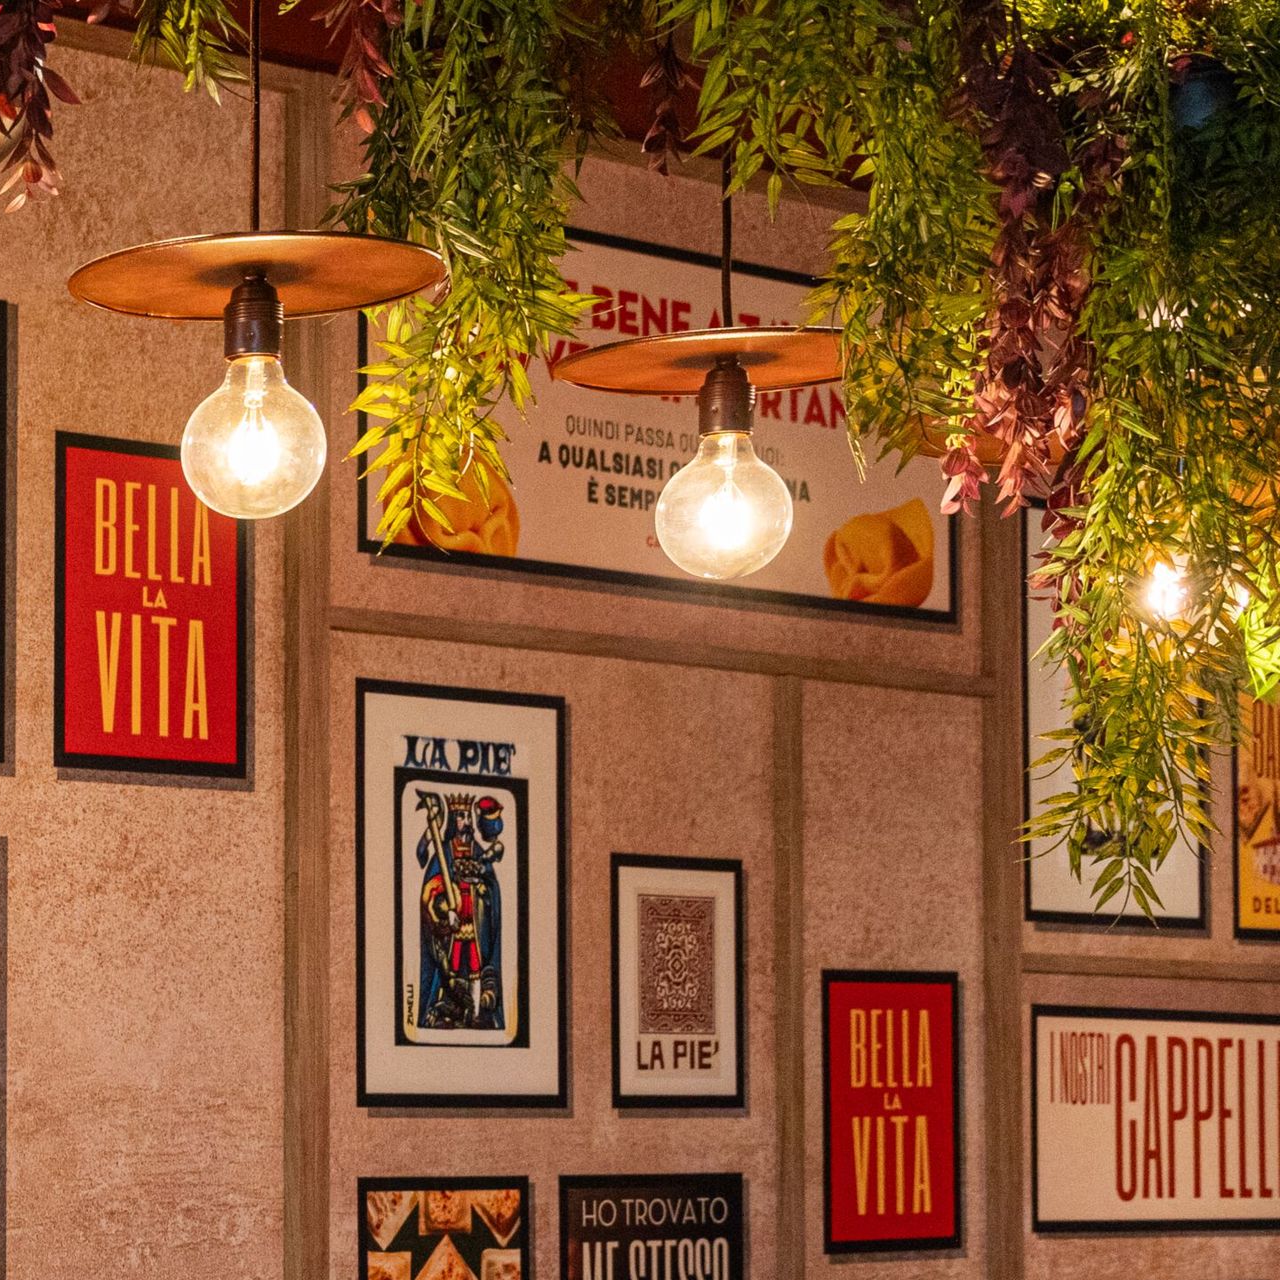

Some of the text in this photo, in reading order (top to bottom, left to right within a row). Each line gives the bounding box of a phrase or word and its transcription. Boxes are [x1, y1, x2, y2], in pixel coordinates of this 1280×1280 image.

[565, 415, 619, 440] QUINDI
[624, 422, 674, 449] PASSA
[538, 441, 551, 464] A
[558, 444, 663, 480] QUALSIASI
[587, 475, 660, 512] È SEMP
[95, 477, 212, 586] BELLA
[142, 586, 167, 609] LA
[95, 610, 209, 740] VITA
[401, 735, 452, 771] LA
[637, 1041, 665, 1070] LA
[849, 1008, 933, 1090] BELLA
[883, 1093, 903, 1111] LA
[1050, 1031, 1280, 1202] I NOSTRI CAPPELL
[851, 1115, 932, 1216] VITA
[582, 1197, 728, 1227] HO TROVATO
